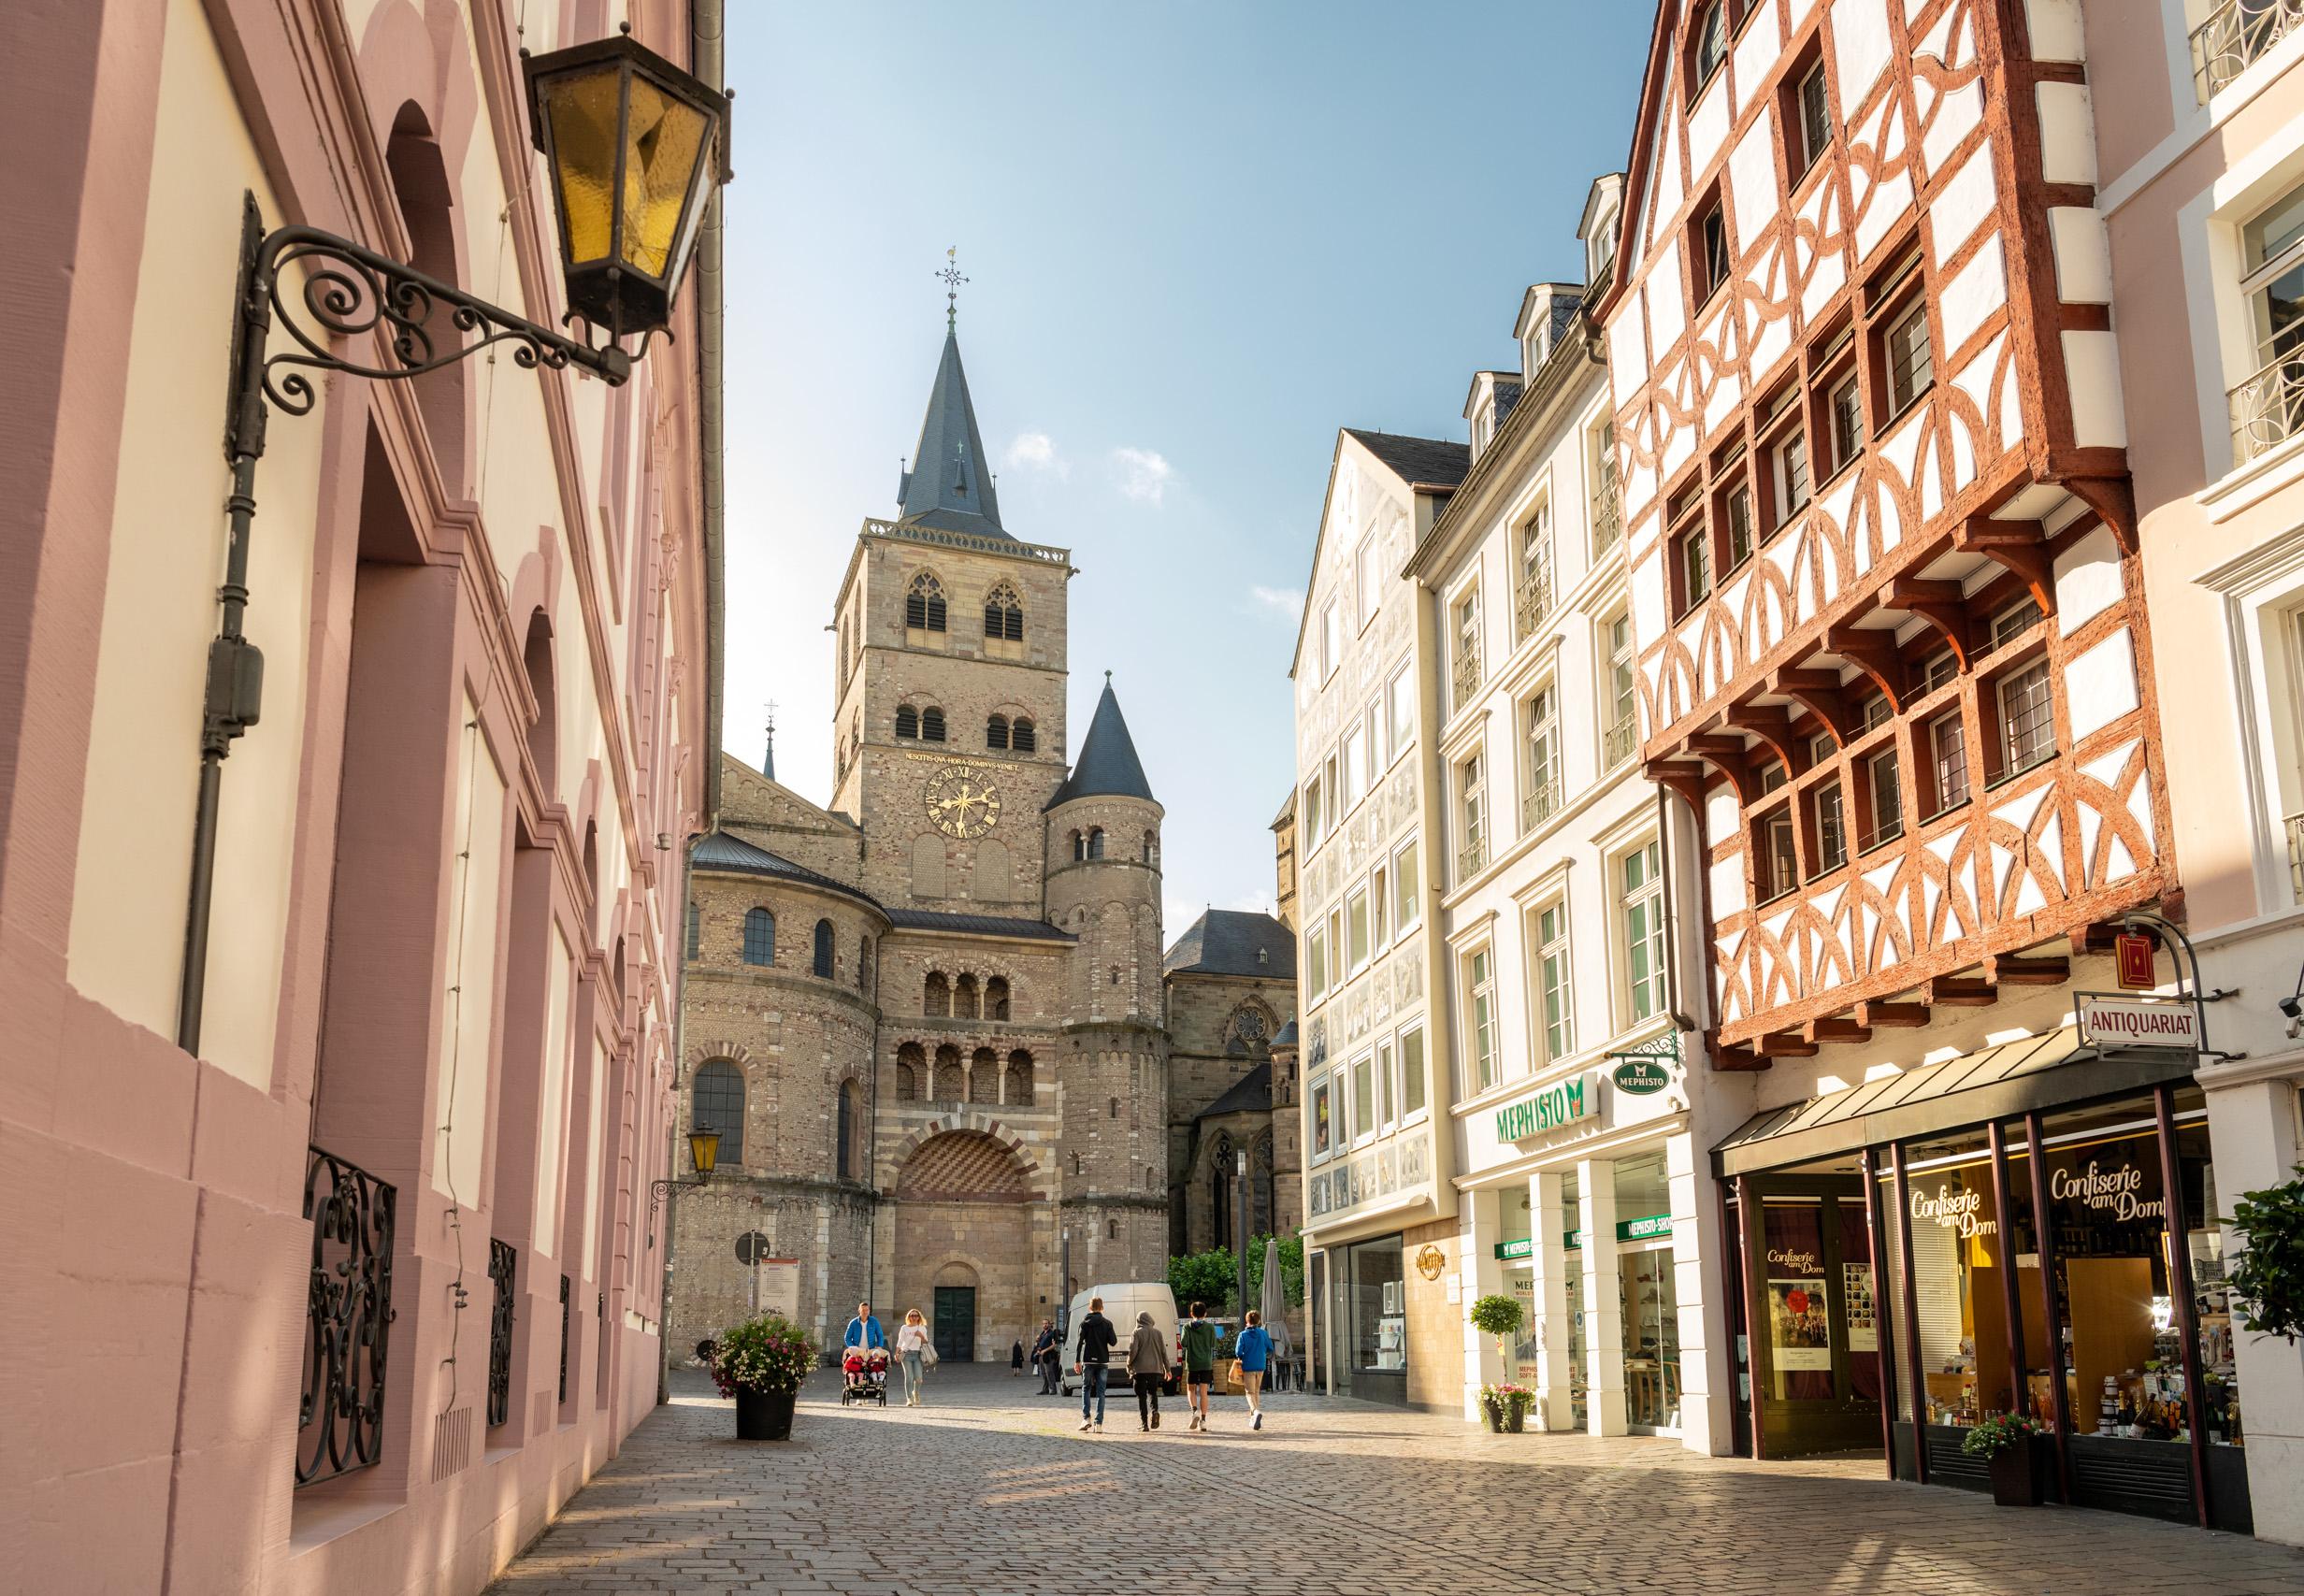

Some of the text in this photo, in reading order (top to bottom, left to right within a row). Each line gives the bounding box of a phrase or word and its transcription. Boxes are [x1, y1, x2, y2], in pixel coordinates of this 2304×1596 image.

[947, 757, 966, 766] HORA
[2091, 1011, 2192, 1037] ANTIQUARIAT
[1620, 1077, 1664, 1086] MEPHISTO
[1496, 1086, 1564, 1143] MEPHISTO
[2052, 1160, 2141, 1204] Confiserie
[1911, 1185, 1980, 1224] Confiserie
[2091, 1190, 2165, 1222] am Dom
[1941, 1212, 1997, 1239] am Dom
[1767, 1248, 1815, 1266] Confiserie
[1800, 1261, 1824, 1274] Dom
